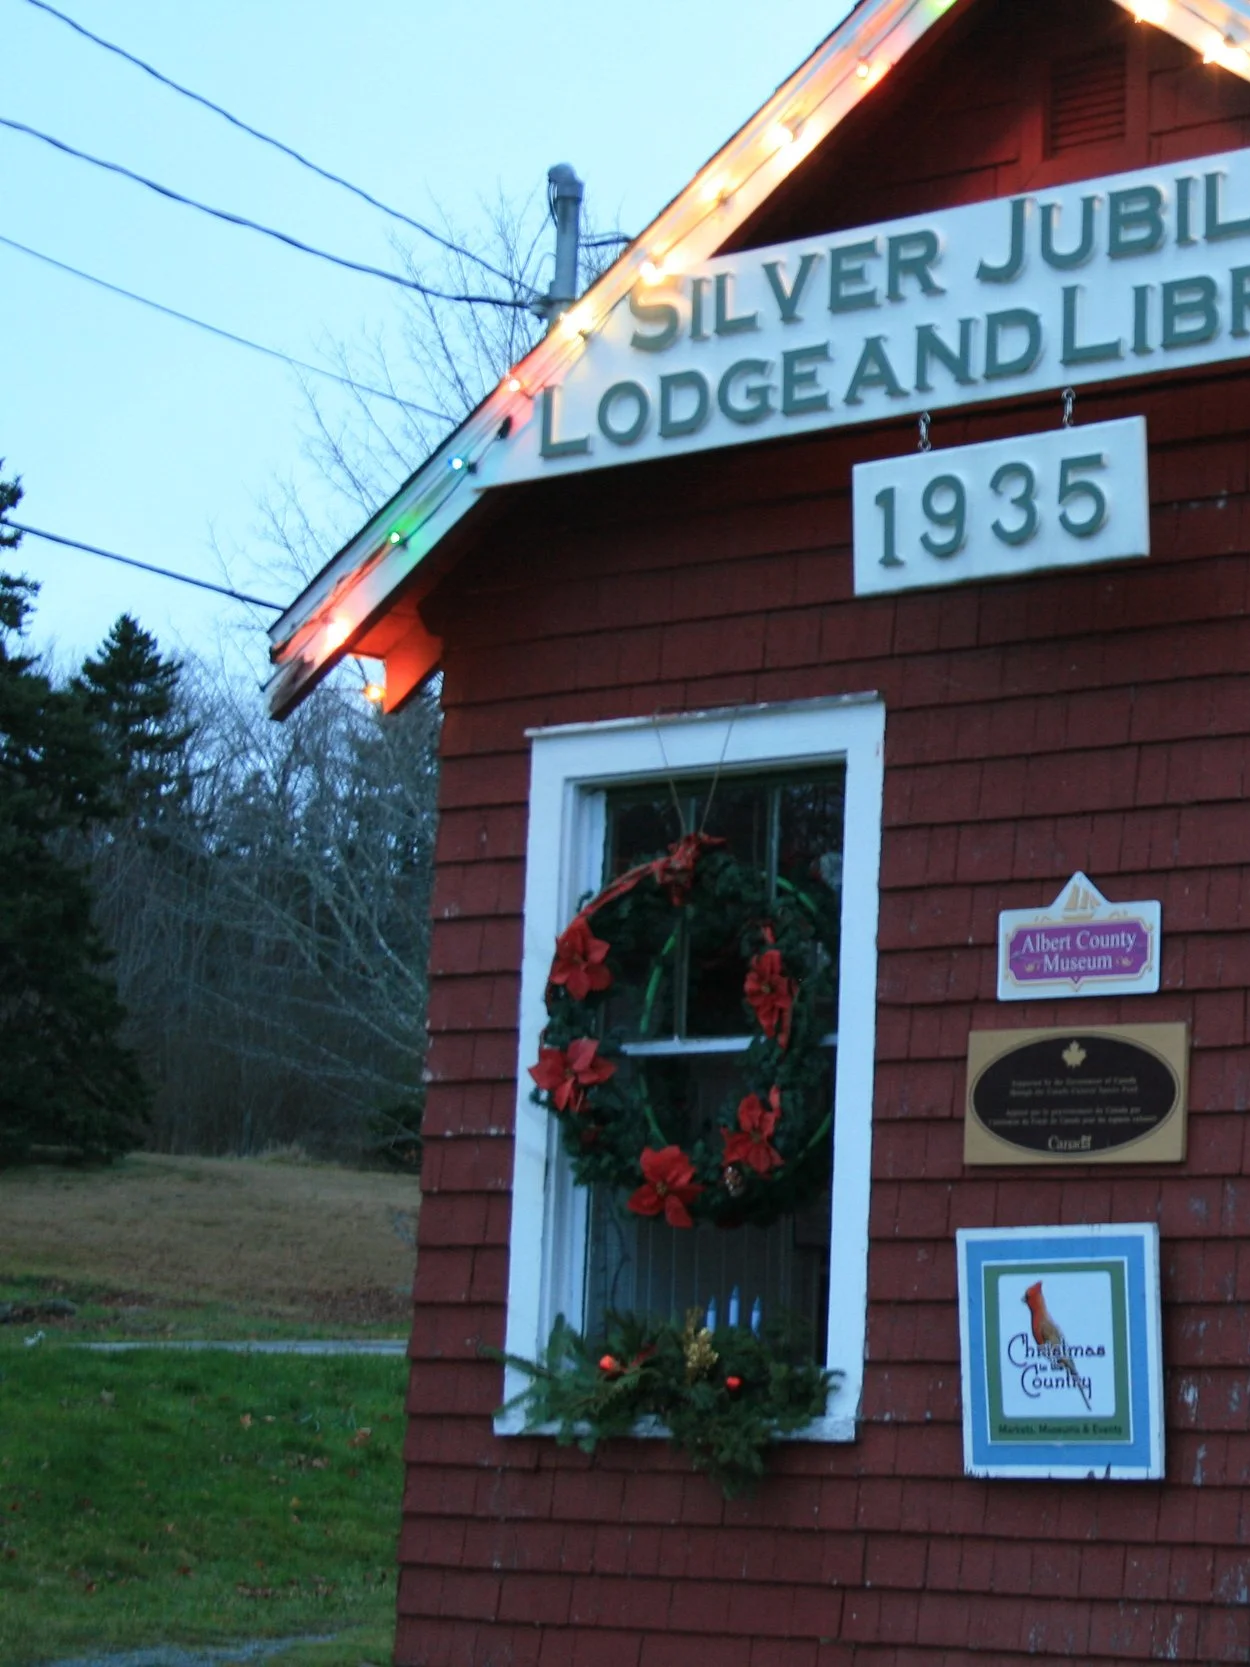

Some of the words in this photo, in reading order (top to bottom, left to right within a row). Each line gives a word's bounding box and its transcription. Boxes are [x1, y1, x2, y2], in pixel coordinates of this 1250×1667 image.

[629, 228, 946, 353] SILVER
[538, 341, 834, 459] LODGE
[842, 308, 1043, 406] AND
[874, 452, 1107, 568] 1935
[1021, 931, 1071, 955] Albert
[1076, 929, 1137, 954] County
[1043, 954, 1113, 974] Museum
[1008, 1333, 1105, 1367] Christmas
[1021, 1363, 1092, 1399] Country
